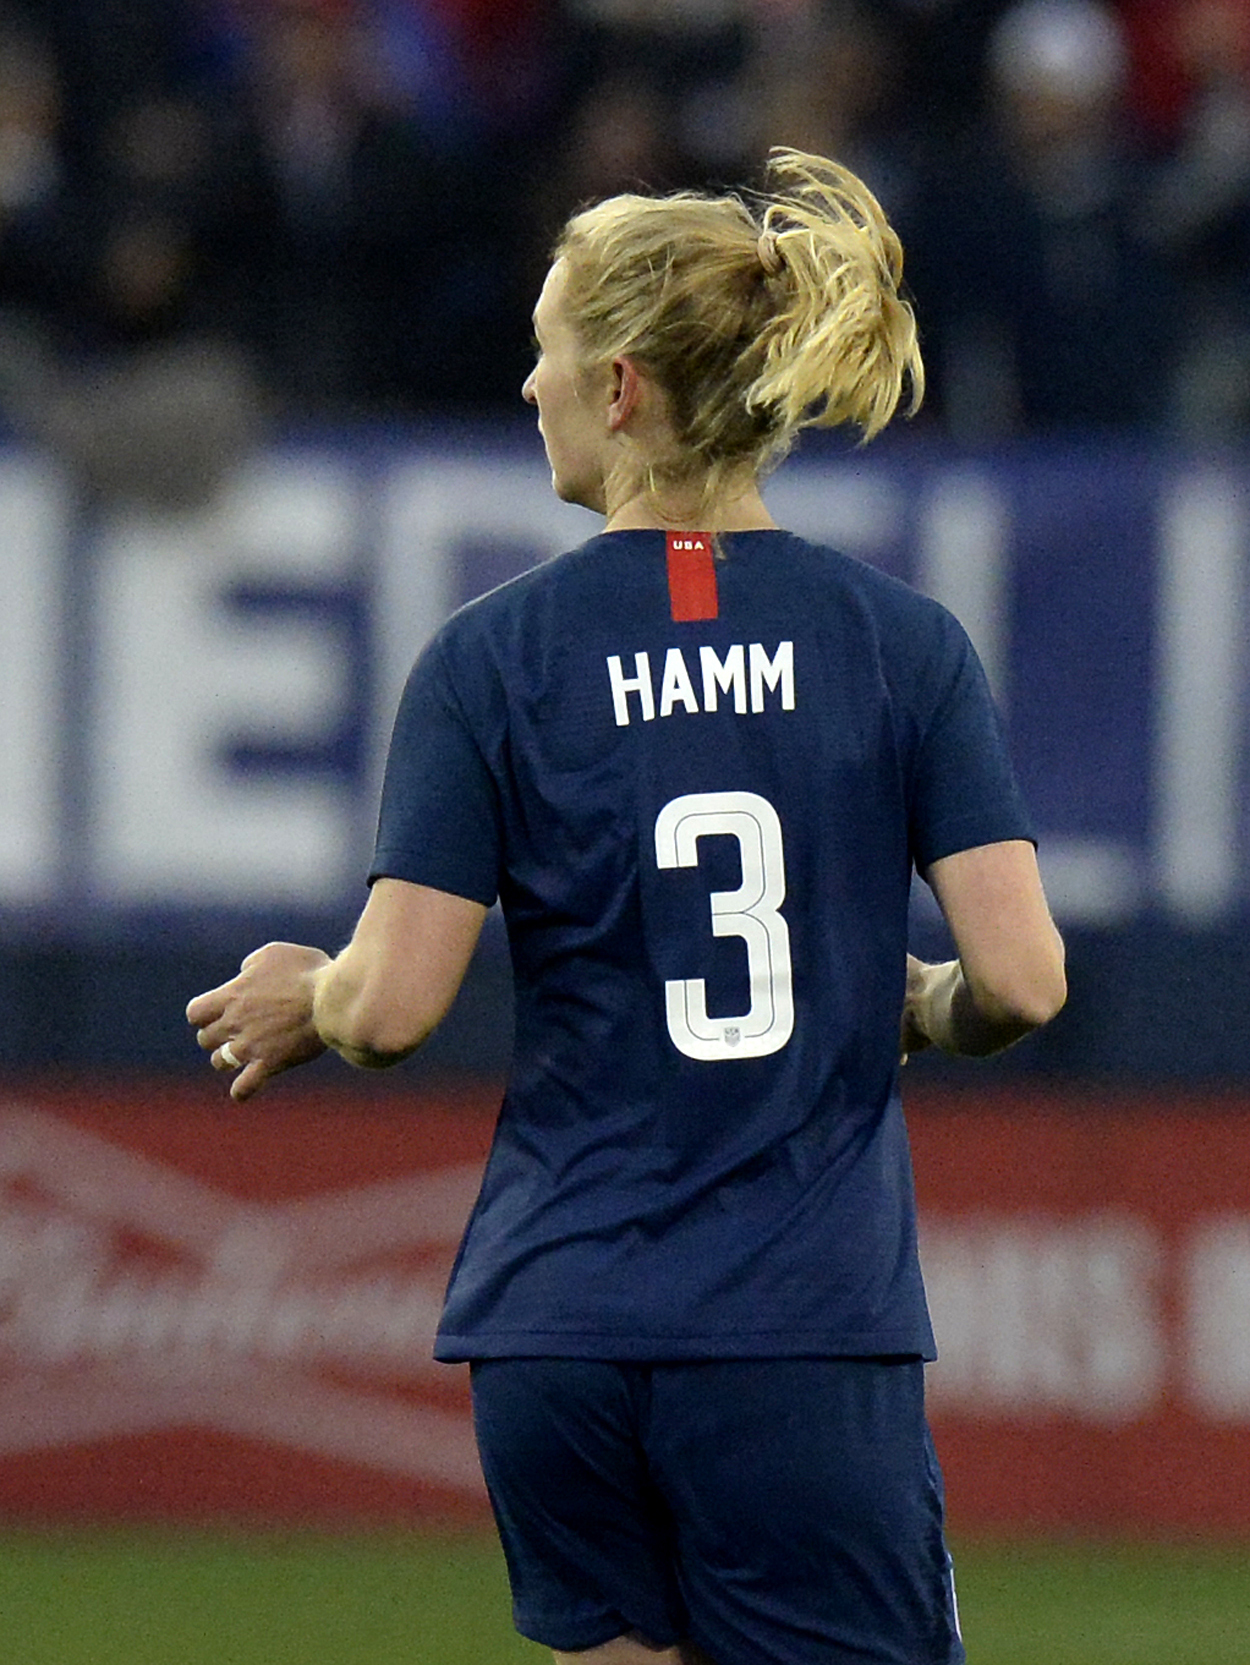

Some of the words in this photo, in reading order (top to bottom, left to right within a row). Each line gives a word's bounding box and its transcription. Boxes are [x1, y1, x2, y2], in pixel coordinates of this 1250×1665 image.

[673, 540, 704, 550] USA
[607, 641, 795, 726] HAMM
[655, 791, 794, 1061] 3
